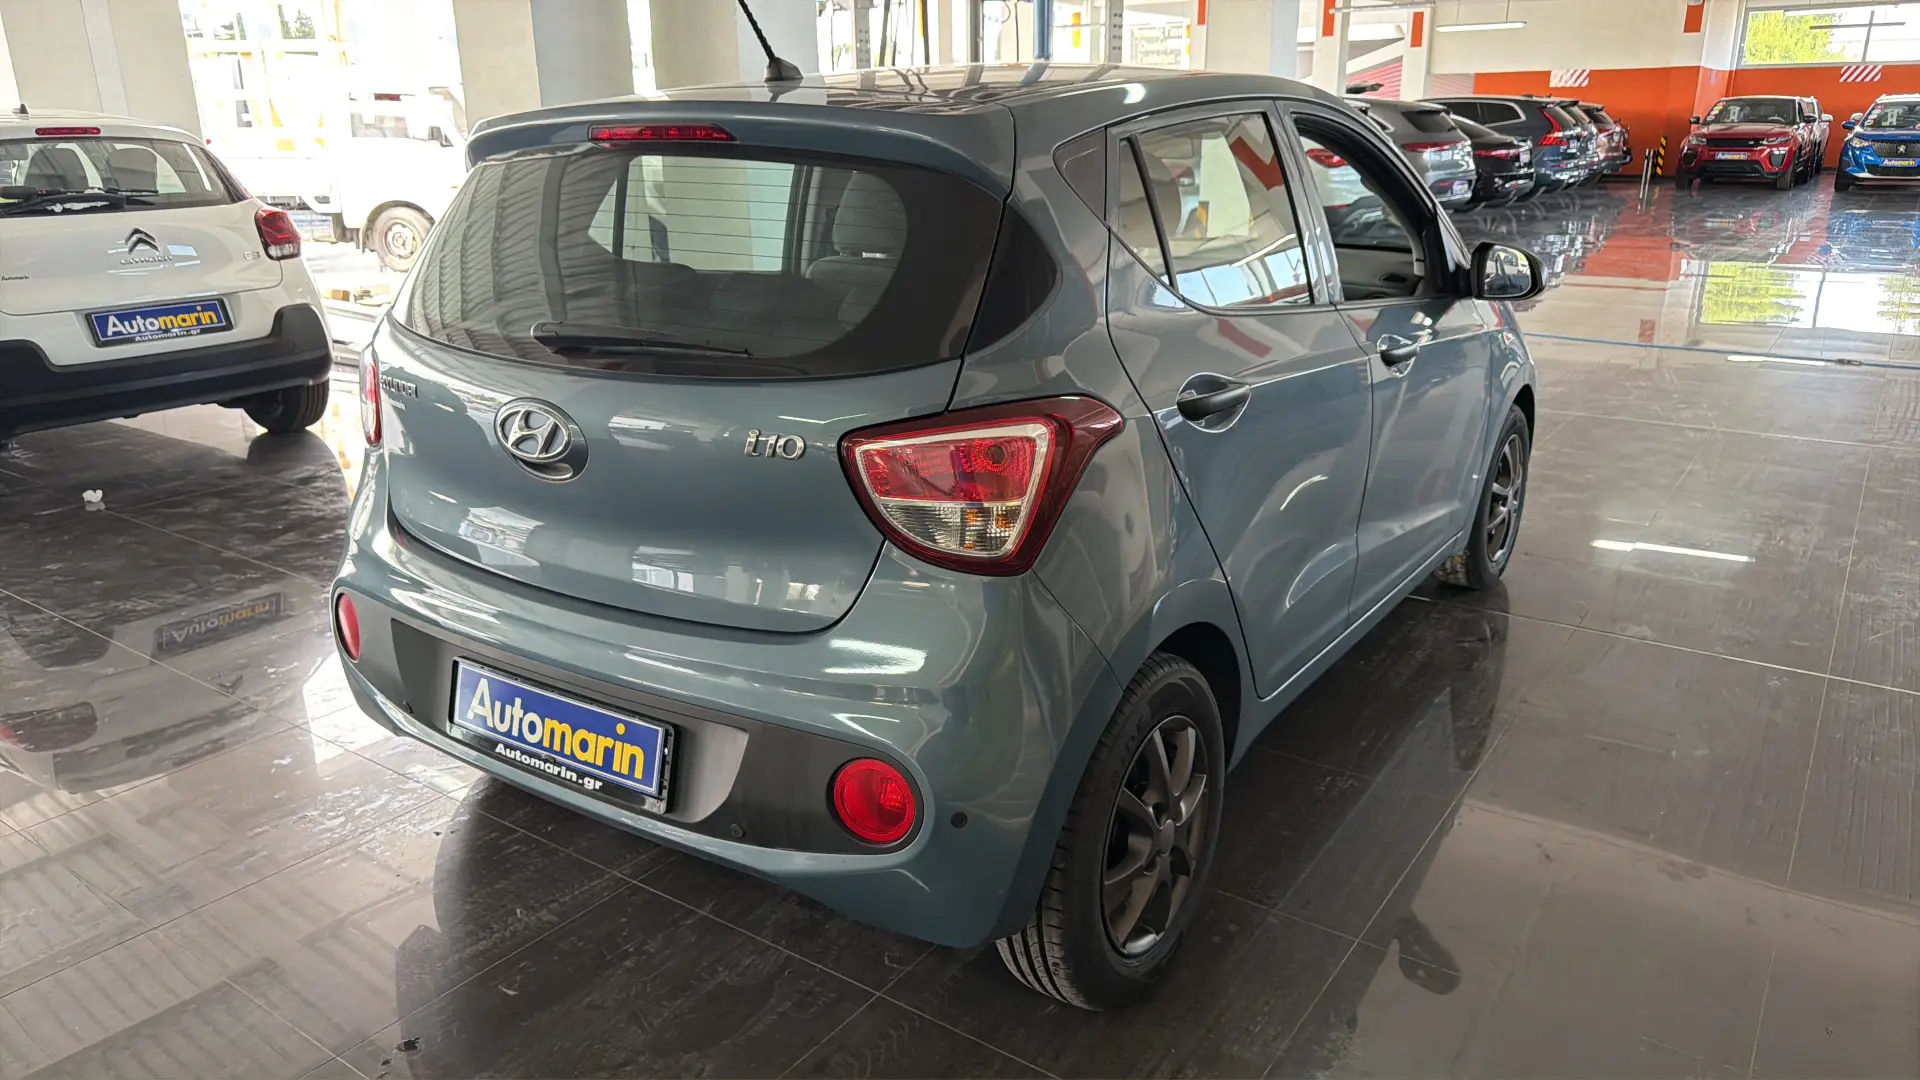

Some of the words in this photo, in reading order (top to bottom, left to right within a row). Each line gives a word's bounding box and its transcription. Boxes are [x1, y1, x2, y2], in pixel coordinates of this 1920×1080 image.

[107, 306, 218, 337] Automarin
[135, 328, 201, 342] Automarin.gr
[744, 429, 805, 459] i10
[466, 677, 645, 780] Automarin
[494, 742, 603, 791] Automarin.gr
